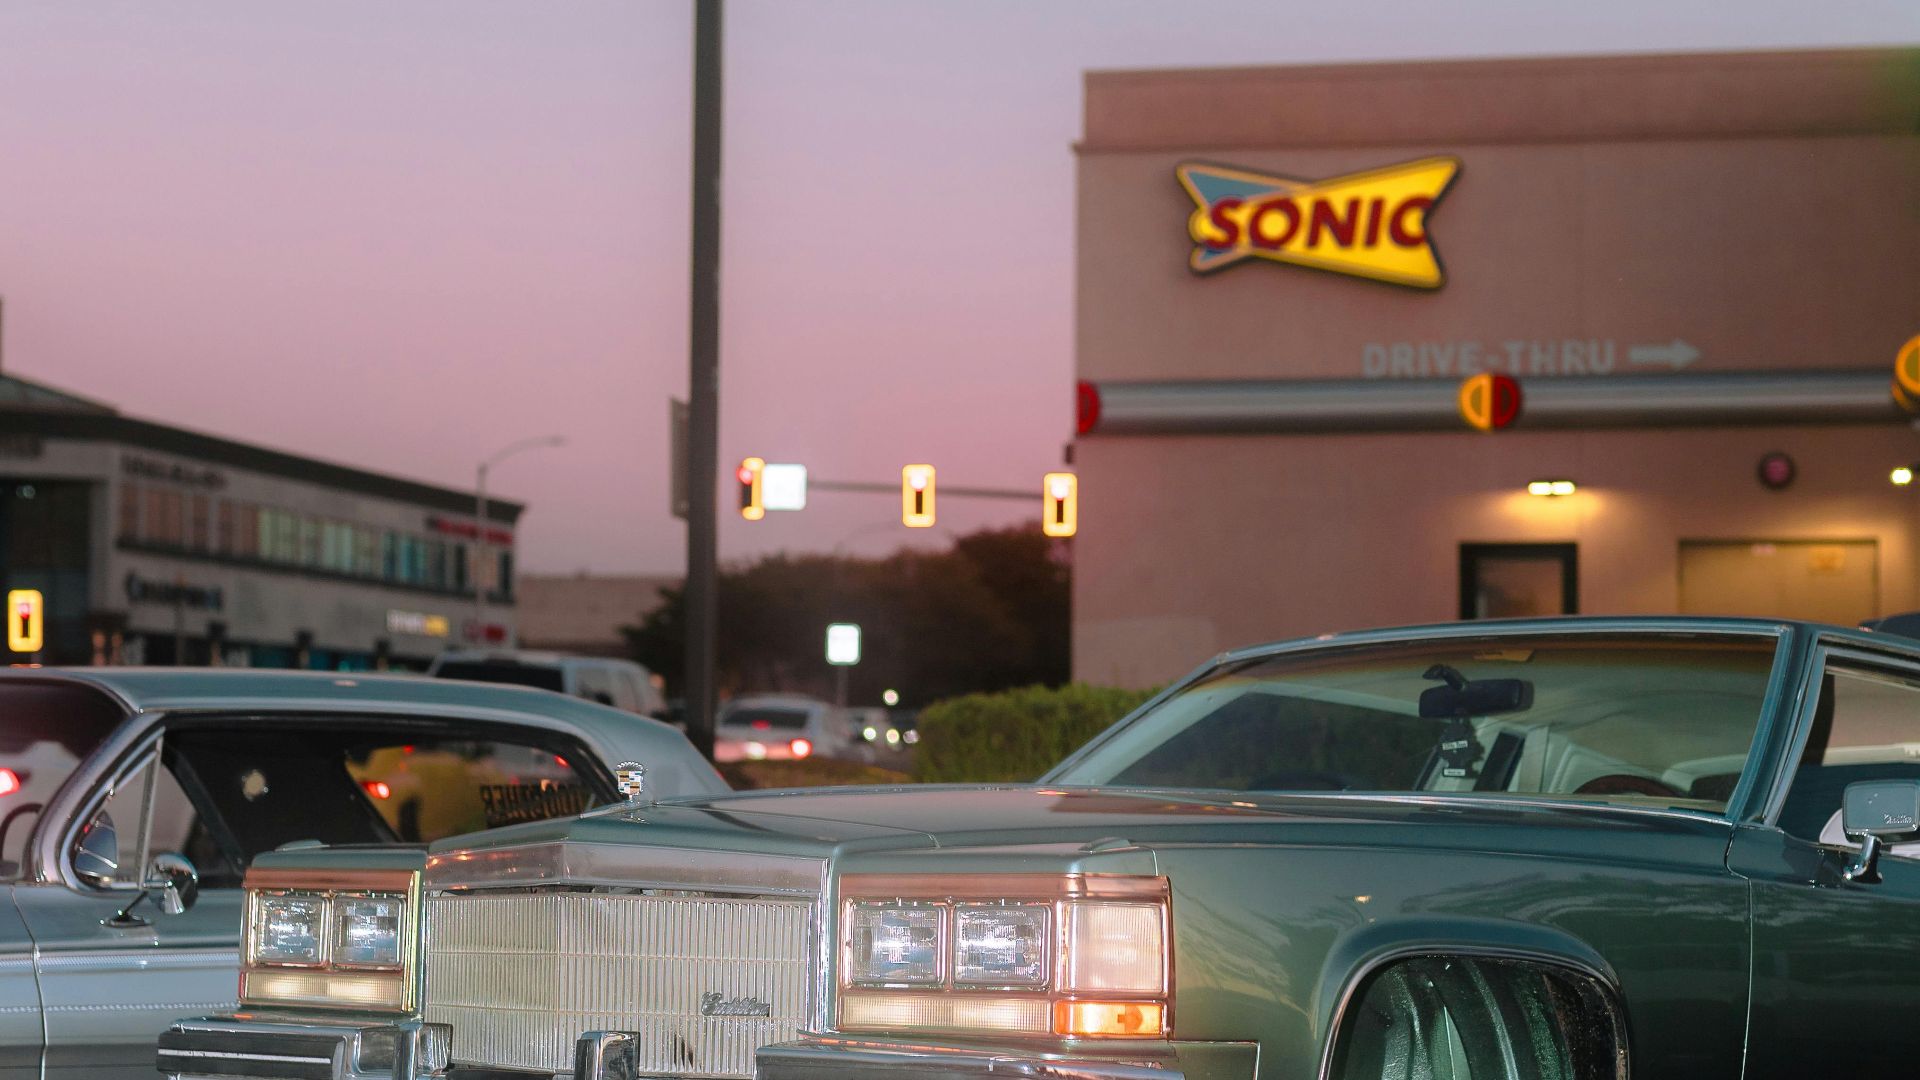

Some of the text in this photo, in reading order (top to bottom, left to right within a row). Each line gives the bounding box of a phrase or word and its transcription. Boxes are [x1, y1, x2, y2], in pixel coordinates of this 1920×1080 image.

[1203, 196, 1433, 249] SONIC
[1364, 340, 1614, 377] DRIVE-THRU
[701, 991, 770, 1016] Cadll
